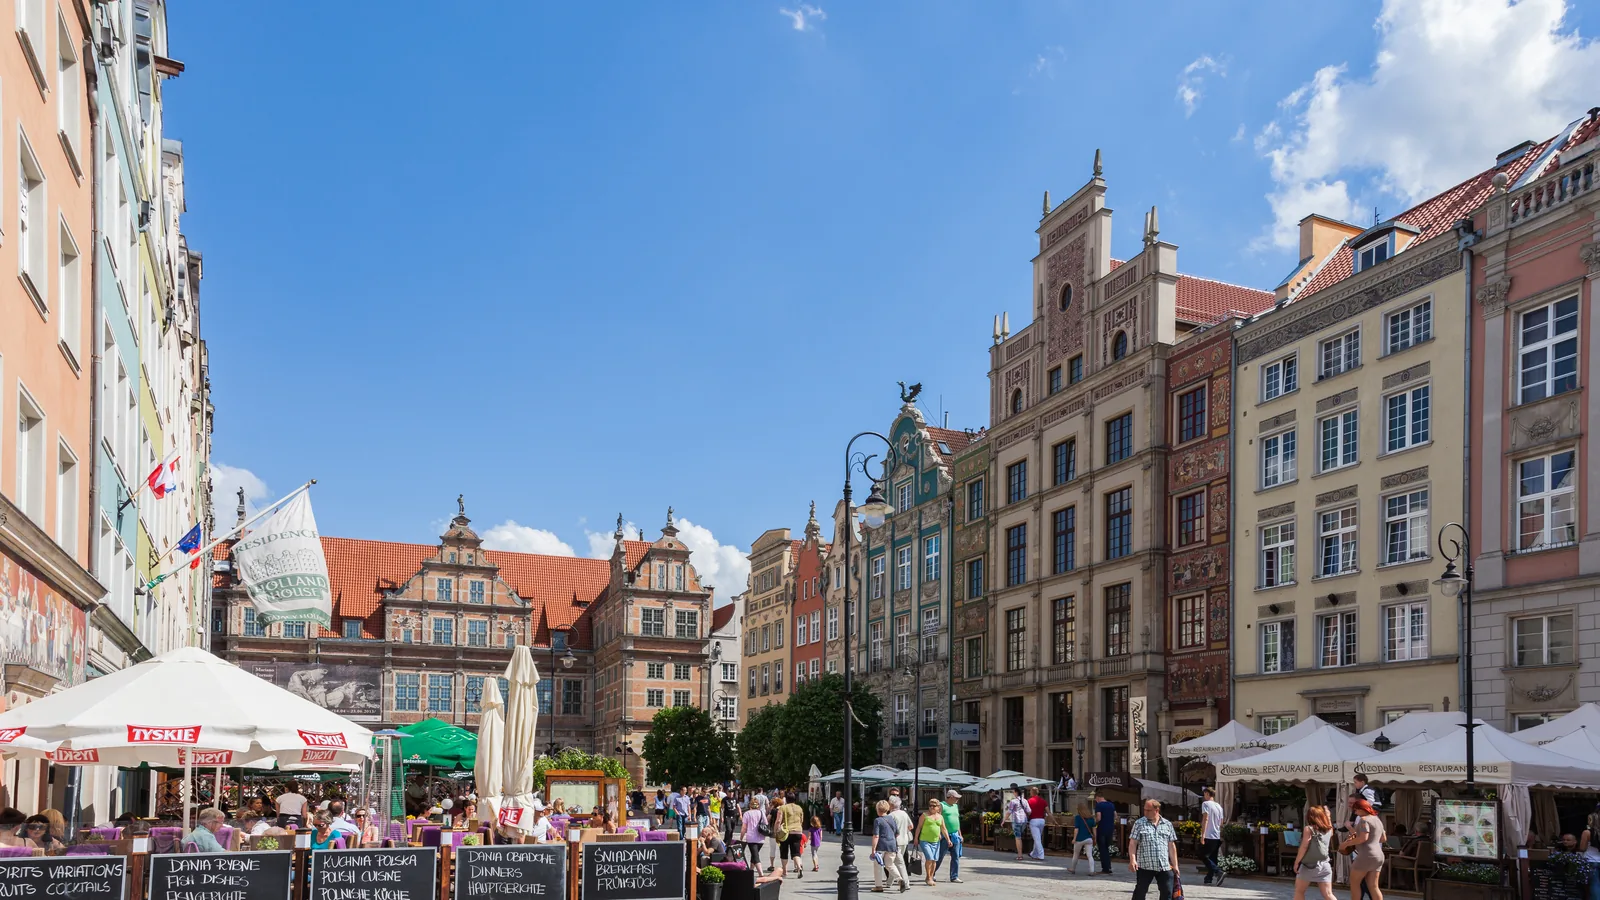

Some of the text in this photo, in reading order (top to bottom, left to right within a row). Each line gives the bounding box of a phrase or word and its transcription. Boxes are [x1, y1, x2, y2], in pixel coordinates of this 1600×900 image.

[235, 529, 320, 554] RESIDENCE
[255, 576, 326, 593] HOLLAND
[270, 587, 319, 599] HOUSE
[132, 728, 196, 742] TYSKIE
[302, 733, 346, 747] TYSKIE
[1220, 764, 1339, 776] Kleopatra RESTAURANT & PUB
[1354, 762, 1402, 775] Kleopatra
[1482, 765, 1499, 773] PUB
[323, 854, 417, 869] KUCHNIA POLSKA
[467, 850, 503, 863] DANIA
[594, 847, 657, 863] ŚNIADANIA
[49, 864, 123, 879] VARIATIONS
[168, 858, 260, 872] DANIA RYBNE
[469, 864, 523, 879] DINNERS
[595, 863, 659, 876] BREAKFAST
[165, 874, 250, 889] FISH DISHES
[320, 870, 355, 885] POLISH
[46, 881, 111, 895] COCKTAILS
[468, 881, 546, 896] HAUPTGERICHTE
